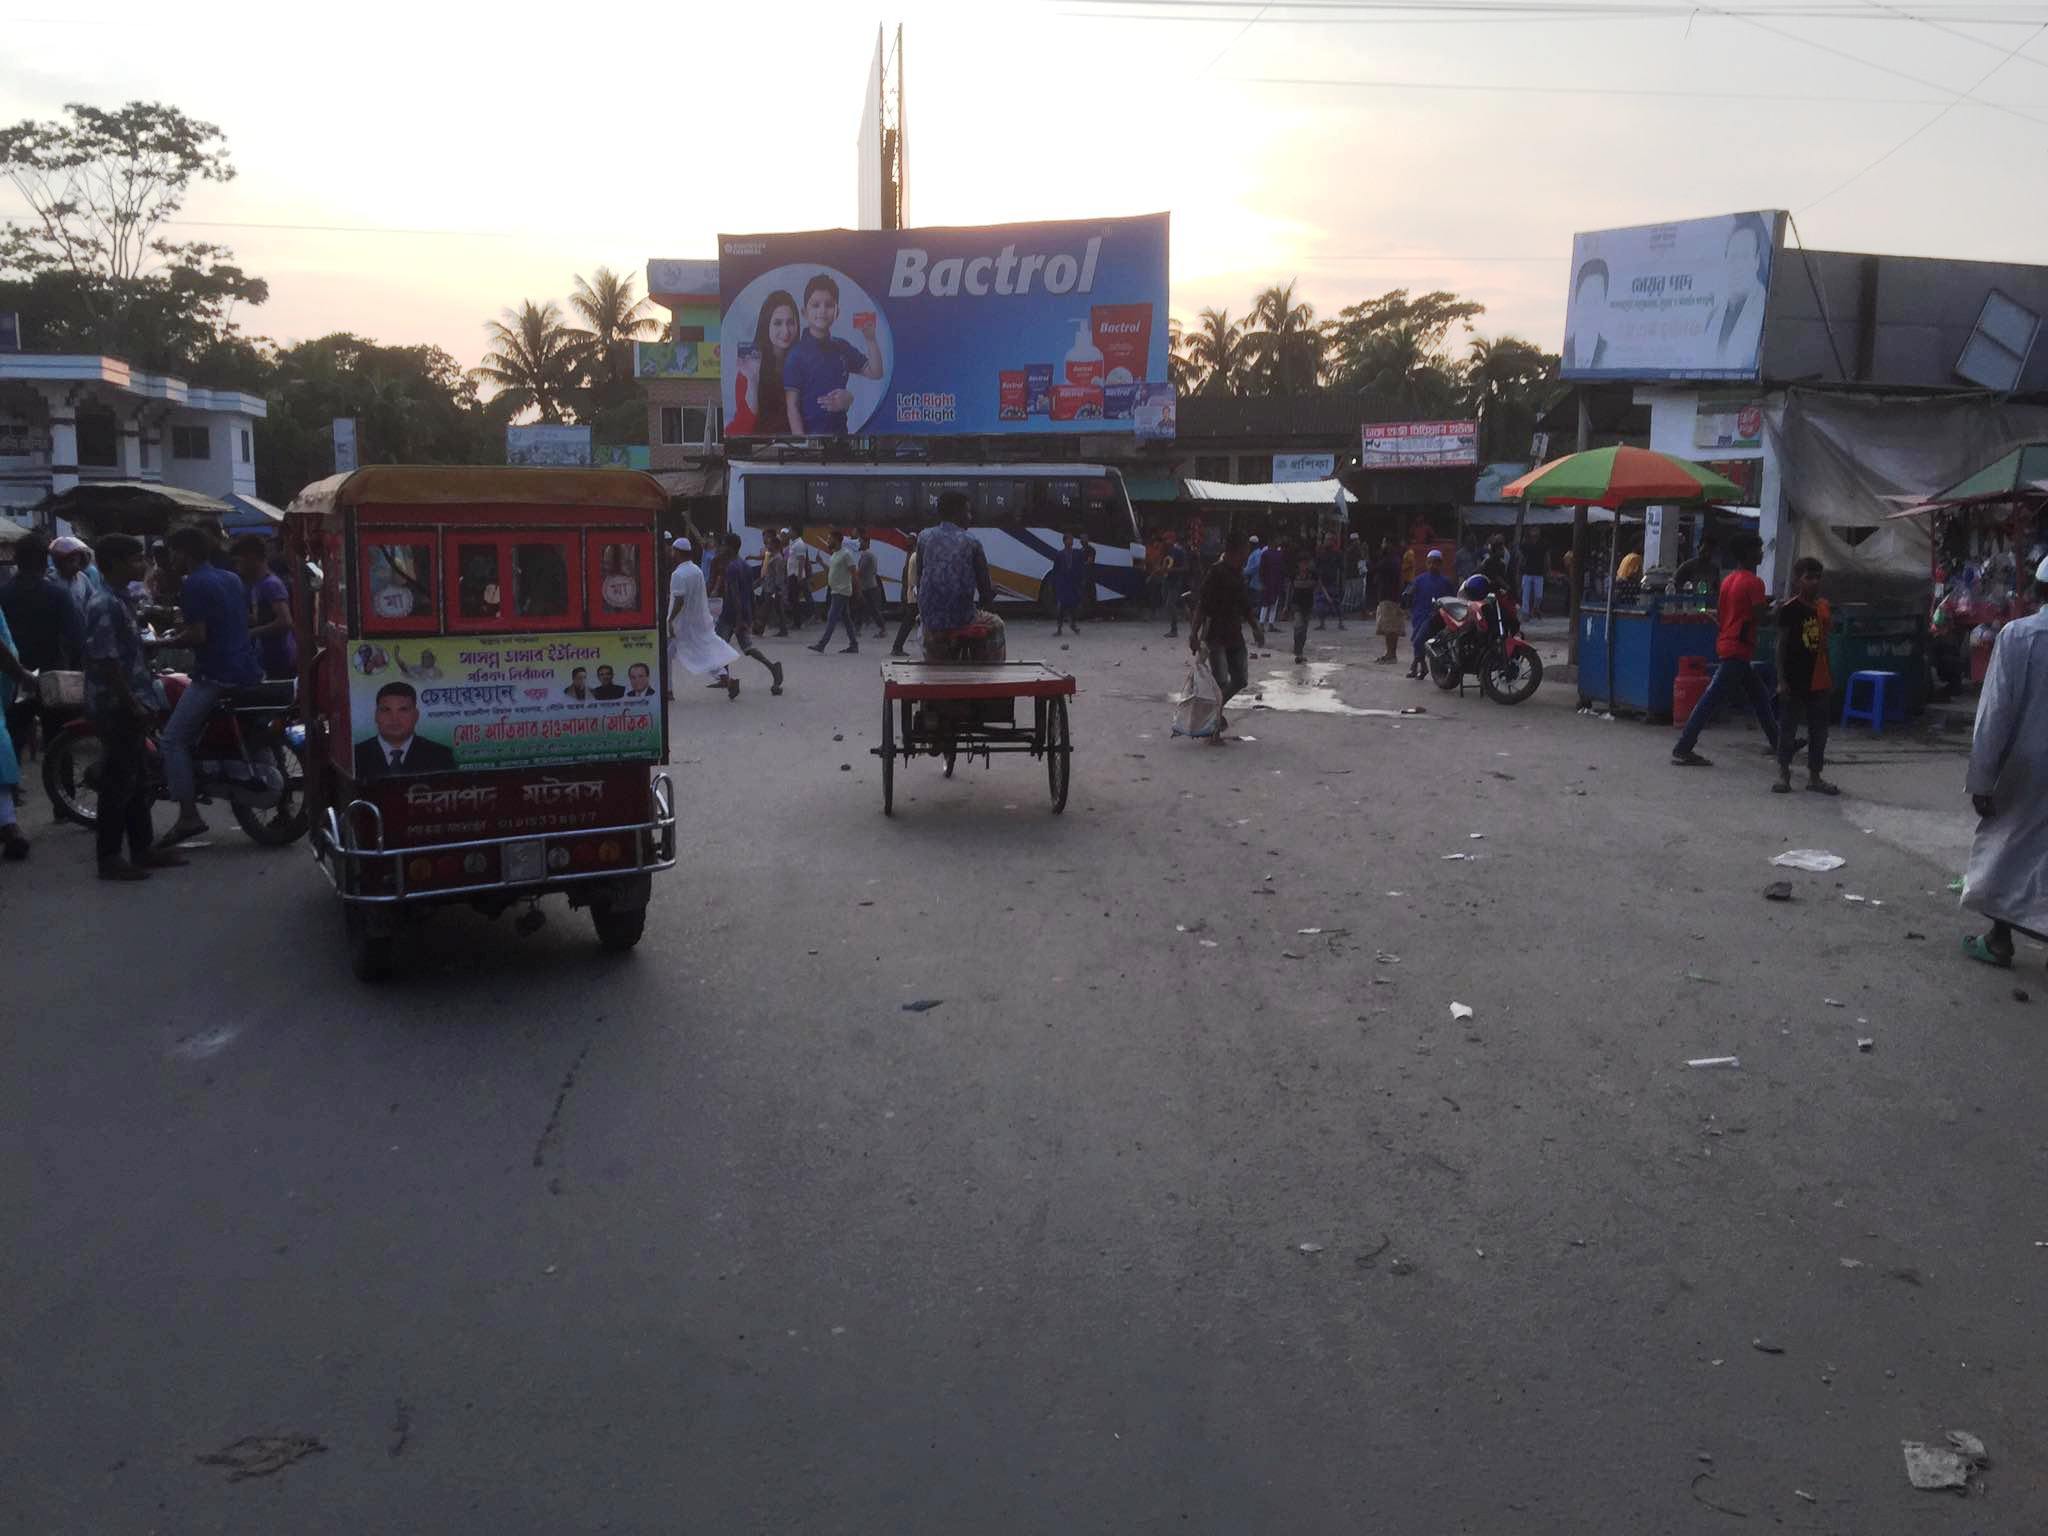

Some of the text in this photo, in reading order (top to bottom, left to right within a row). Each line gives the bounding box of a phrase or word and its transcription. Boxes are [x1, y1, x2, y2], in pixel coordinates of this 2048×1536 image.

[888, 236, 1102, 298] Bactrol
[1100, 320, 1141, 333] Bactrol
[896, 393, 956, 408] Left Right
[896, 407, 956, 424] Left Right
